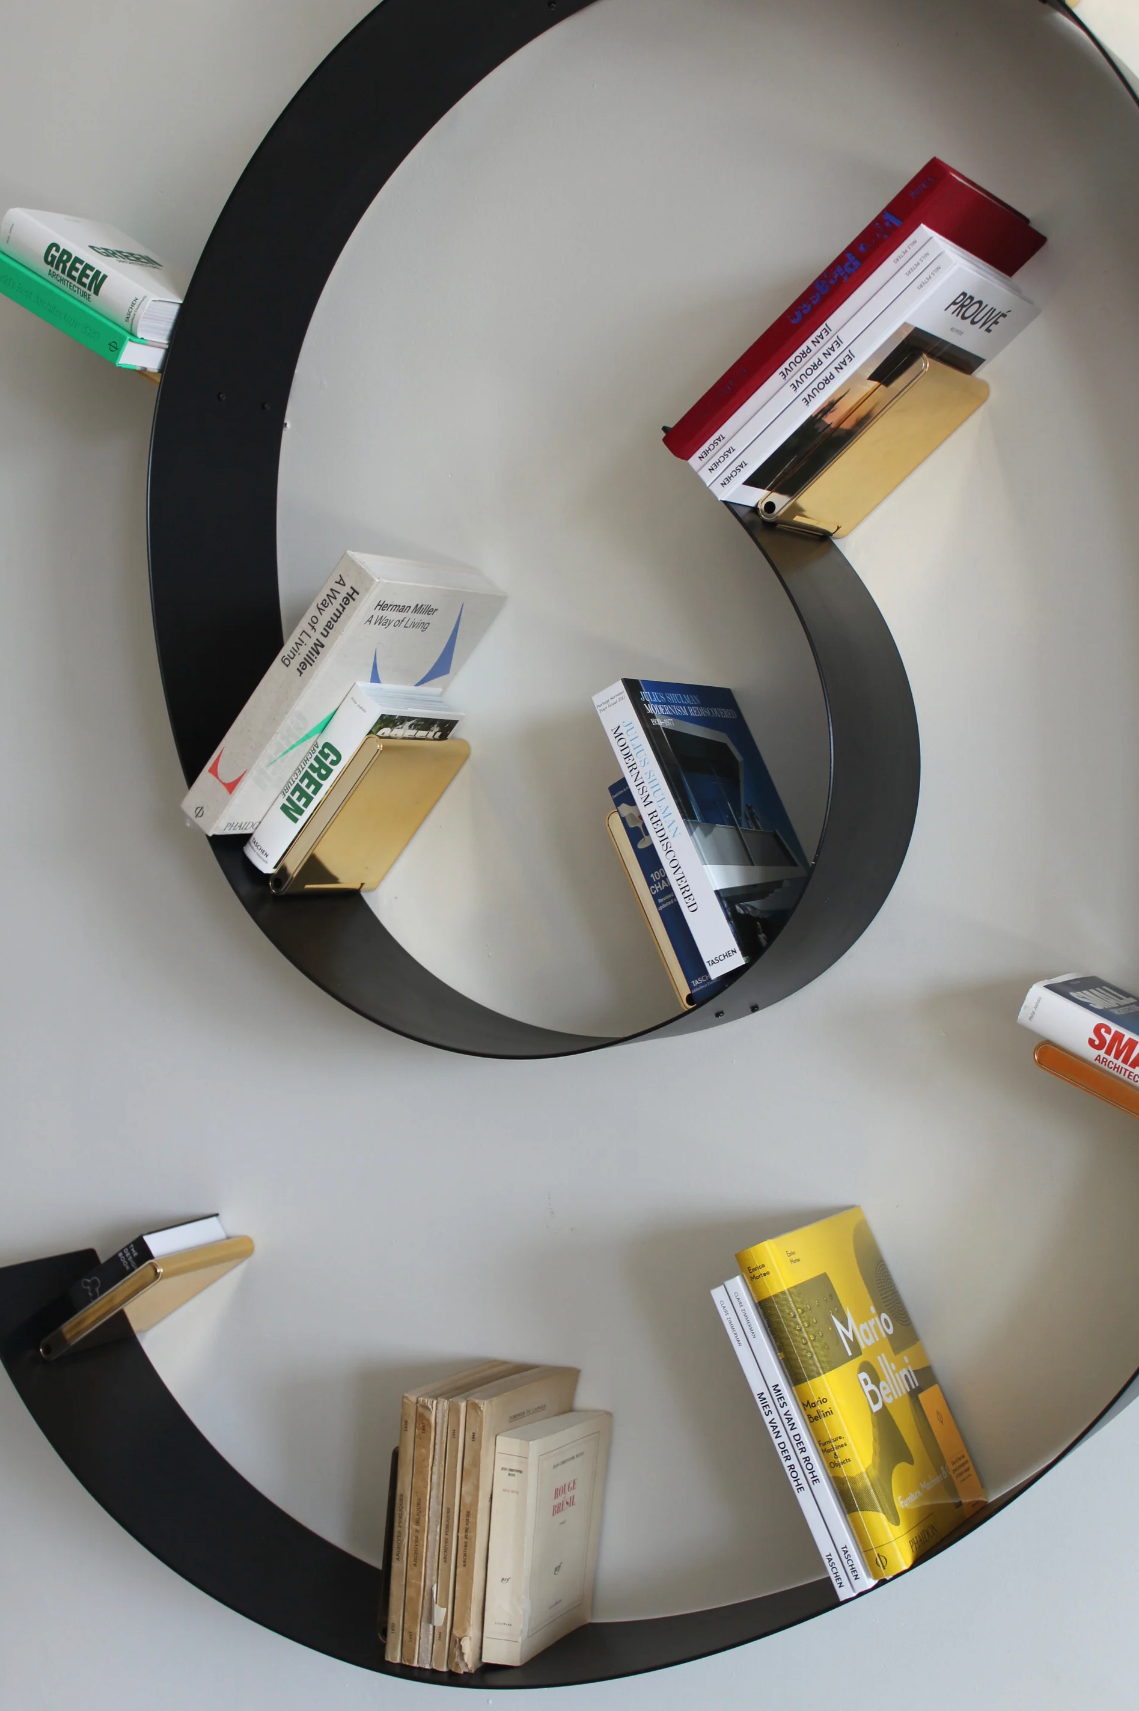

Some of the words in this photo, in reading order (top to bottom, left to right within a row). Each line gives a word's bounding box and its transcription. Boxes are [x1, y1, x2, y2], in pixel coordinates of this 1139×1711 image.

[43, 242, 108, 297] GREEN
[47, 269, 92, 302] ARCHITECTURE
[125, 297, 138, 324] TASCHEN
[944, 291, 1012, 333] PROUVÉ
[811, 323, 832, 347] JEAN
[822, 335, 843, 359] JEAN
[779, 346, 812, 380] PROUVÉ
[834, 350, 855, 373] JEAN
[789, 358, 823, 393] PROUVÉ
[802, 372, 835, 407] PROUVÉ
[698, 434, 726, 461] TASCHEN
[708, 446, 736, 473] TASCHEN
[720, 461, 748, 488] TASCHEN
[335, 574, 346, 587] A
[316, 588, 340, 616] Way
[320, 586, 360, 638] Herman
[374, 600, 411, 614] Herman
[411, 603, 438, 616] Miller
[307, 615, 319, 633] of
[364, 615, 374, 625] A
[374, 615, 393, 629] Way
[394, 616, 405, 627] of
[404, 618, 431, 632] Living
[281, 630, 311, 668] Living
[296, 638, 325, 677] Miller
[640, 692, 666, 702] JULIUS
[665, 693, 700, 704] SHULMAN
[644, 704, 688, 716] MODERNISM
[687, 706, 737, 718] REDISCOVERED
[281, 740, 319, 798] ARCHITECTURE
[622, 721, 649, 768] JULIUS
[644, 769, 682, 838] SHULMAN
[280, 742, 342, 824] GREEN
[611, 725, 653, 808] MODERNISM
[648, 807, 699, 913] REDISCOVERED
[251, 837, 269, 858] TASCHEN
[706, 948, 737, 967] TASCHEN
[118, 1252, 130, 1270] BOOK
[129, 1244, 138, 1257] THE
[748, 1264, 765, 1274] Enrico
[831, 1306, 894, 1357] Mario
[858, 1353, 919, 1413] Bellini
[802, 1397, 828, 1411] Mario
[807, 1407, 833, 1423] Bellini
[757, 1392, 772, 1417] MIES
[769, 1418, 782, 1439] VAN
[778, 1441, 792, 1462] DER
[787, 1464, 805, 1493] ROHE
[772, 1384, 787, 1408] MIES
[784, 1410, 797, 1431] VAN
[793, 1434, 807, 1454] DER
[803, 1456, 820, 1485] ROHE
[829, 1458, 851, 1469] Objects
[553, 1478, 577, 1500] ROUGE
[909, 1522, 938, 1553] PHAIDON
[825, 1553, 844, 1589] TASCHEN
[841, 1545, 860, 1581] TASCHEN
